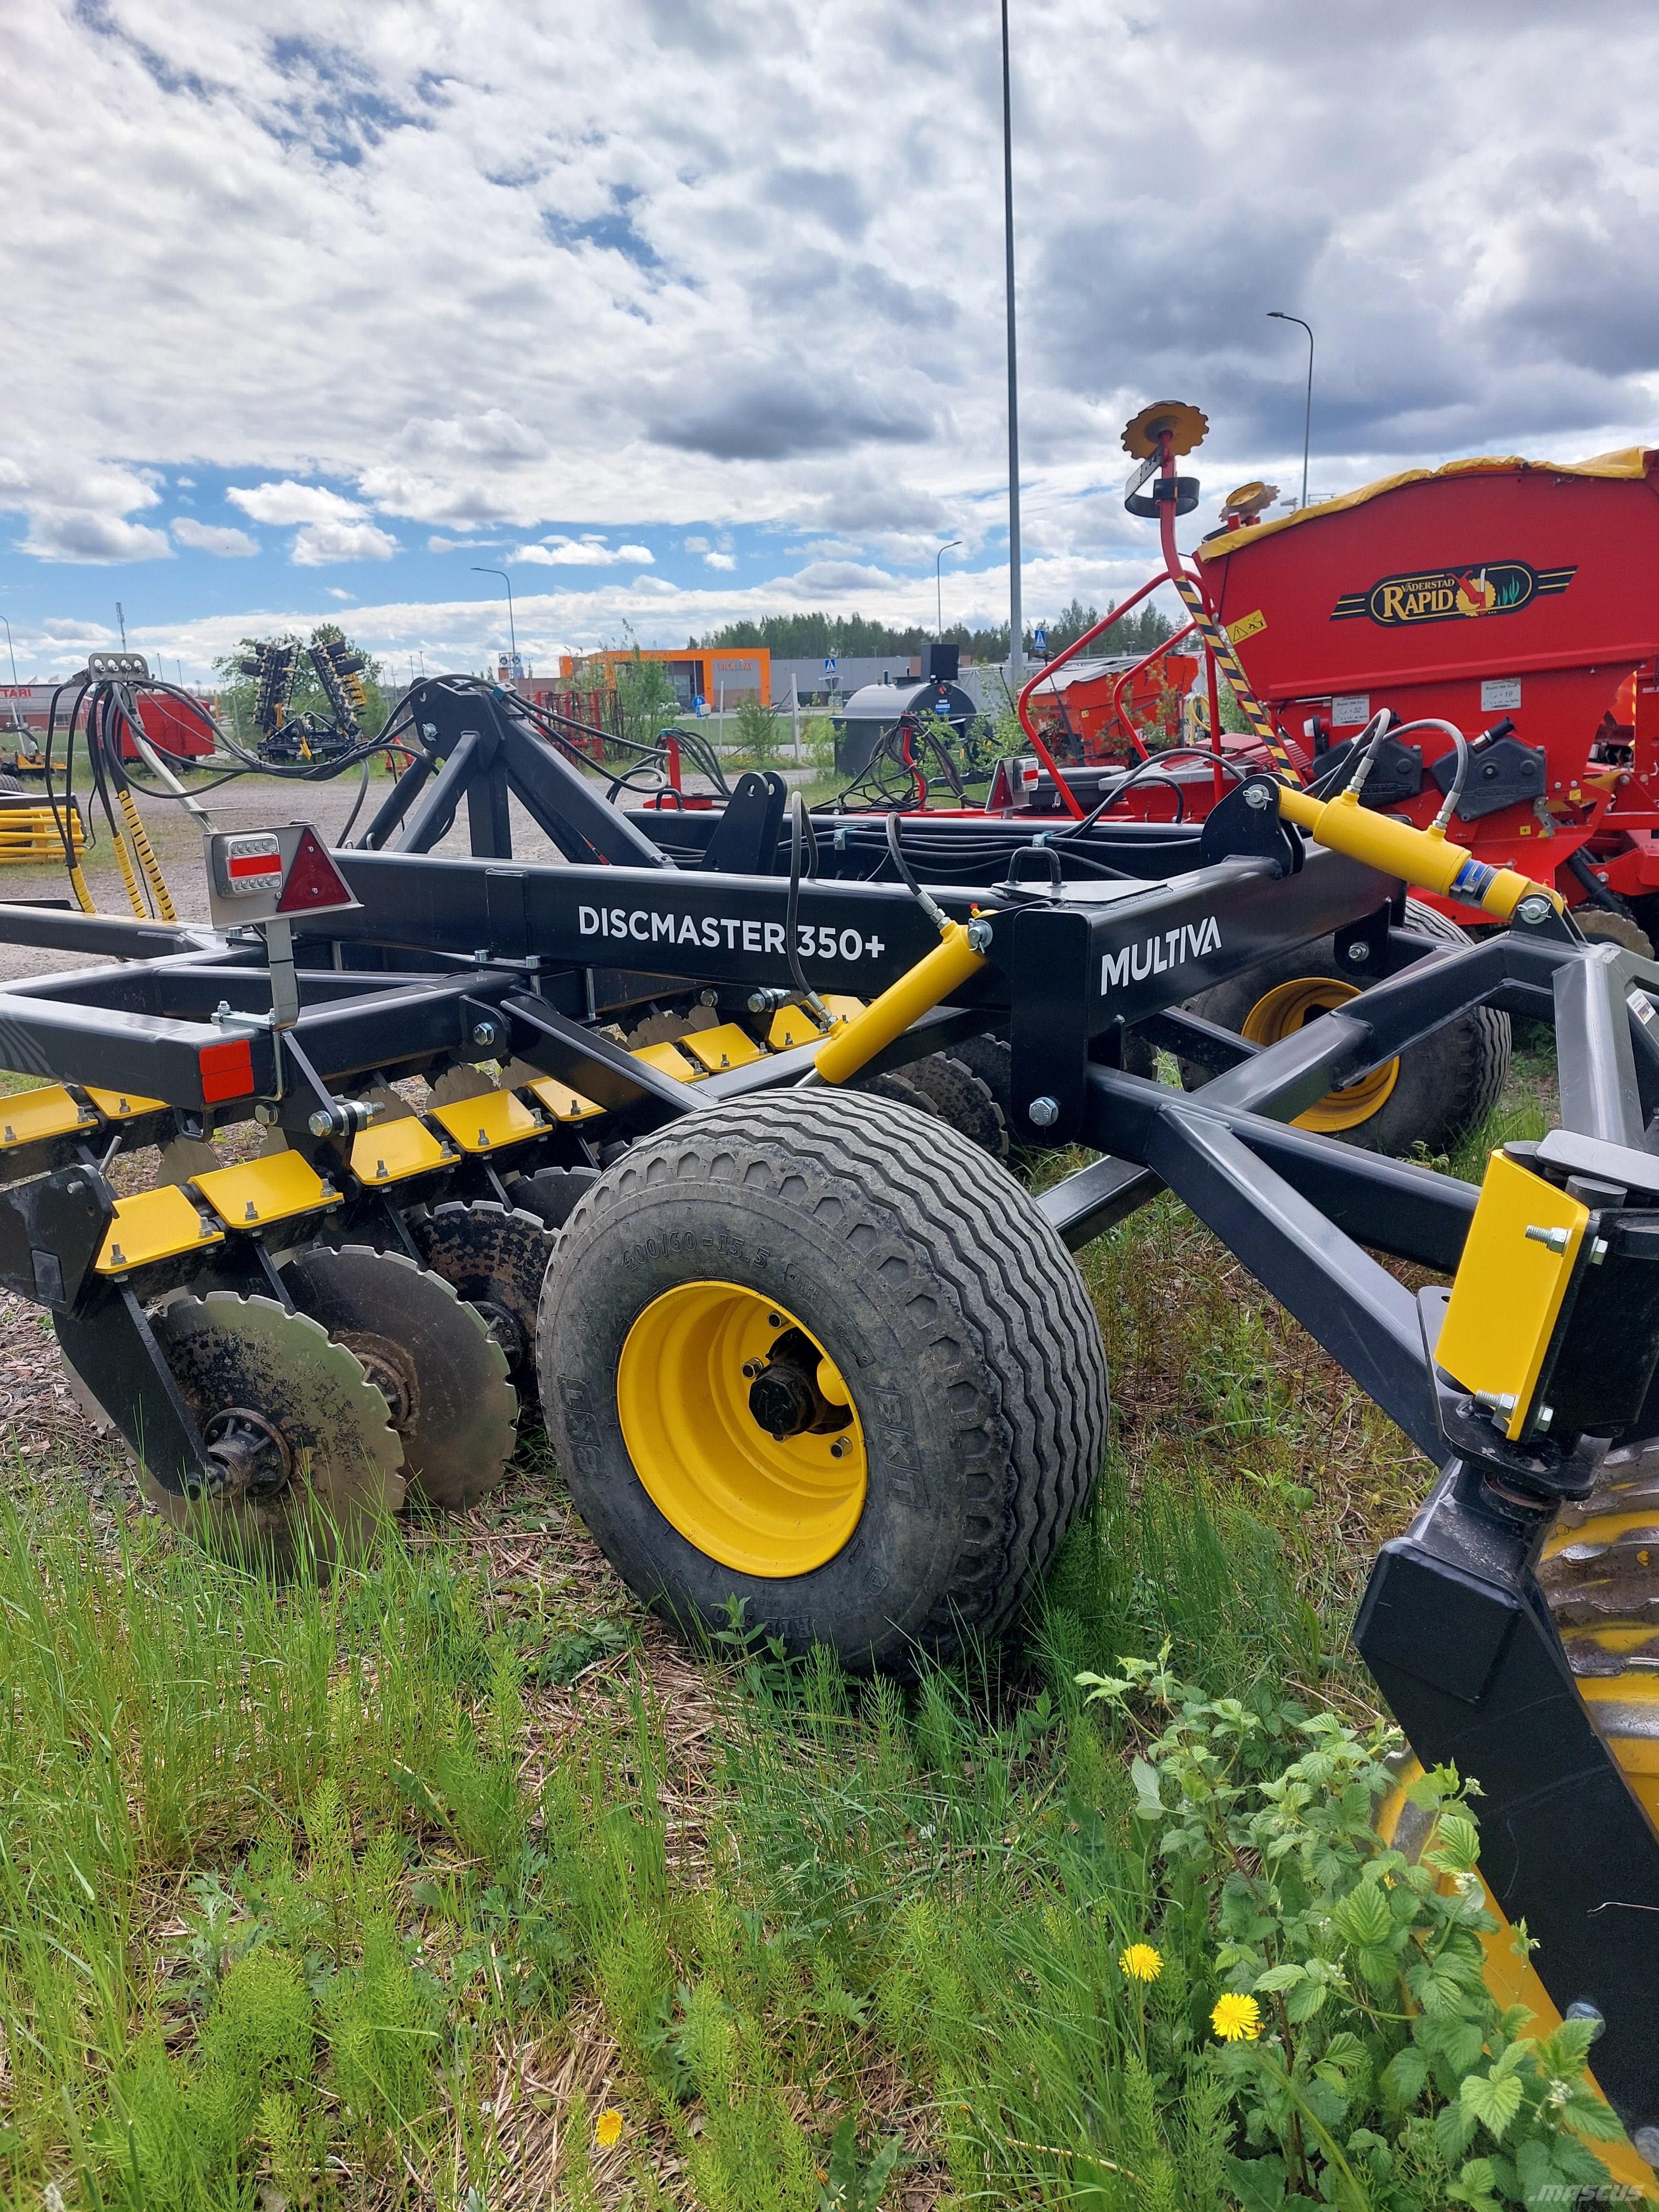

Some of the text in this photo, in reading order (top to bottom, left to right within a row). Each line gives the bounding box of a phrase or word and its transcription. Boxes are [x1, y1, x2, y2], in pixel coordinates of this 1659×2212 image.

[1382, 586, 1454, 620] RAPID
[1401, 578, 1455, 593] VÄDERSTAD
[578, 906, 786, 954] DISCMASTER
[796, 925, 885, 961] 350+
[1101, 916, 1222, 996] MULTIVA
[873, 1389, 923, 1507] BKT
